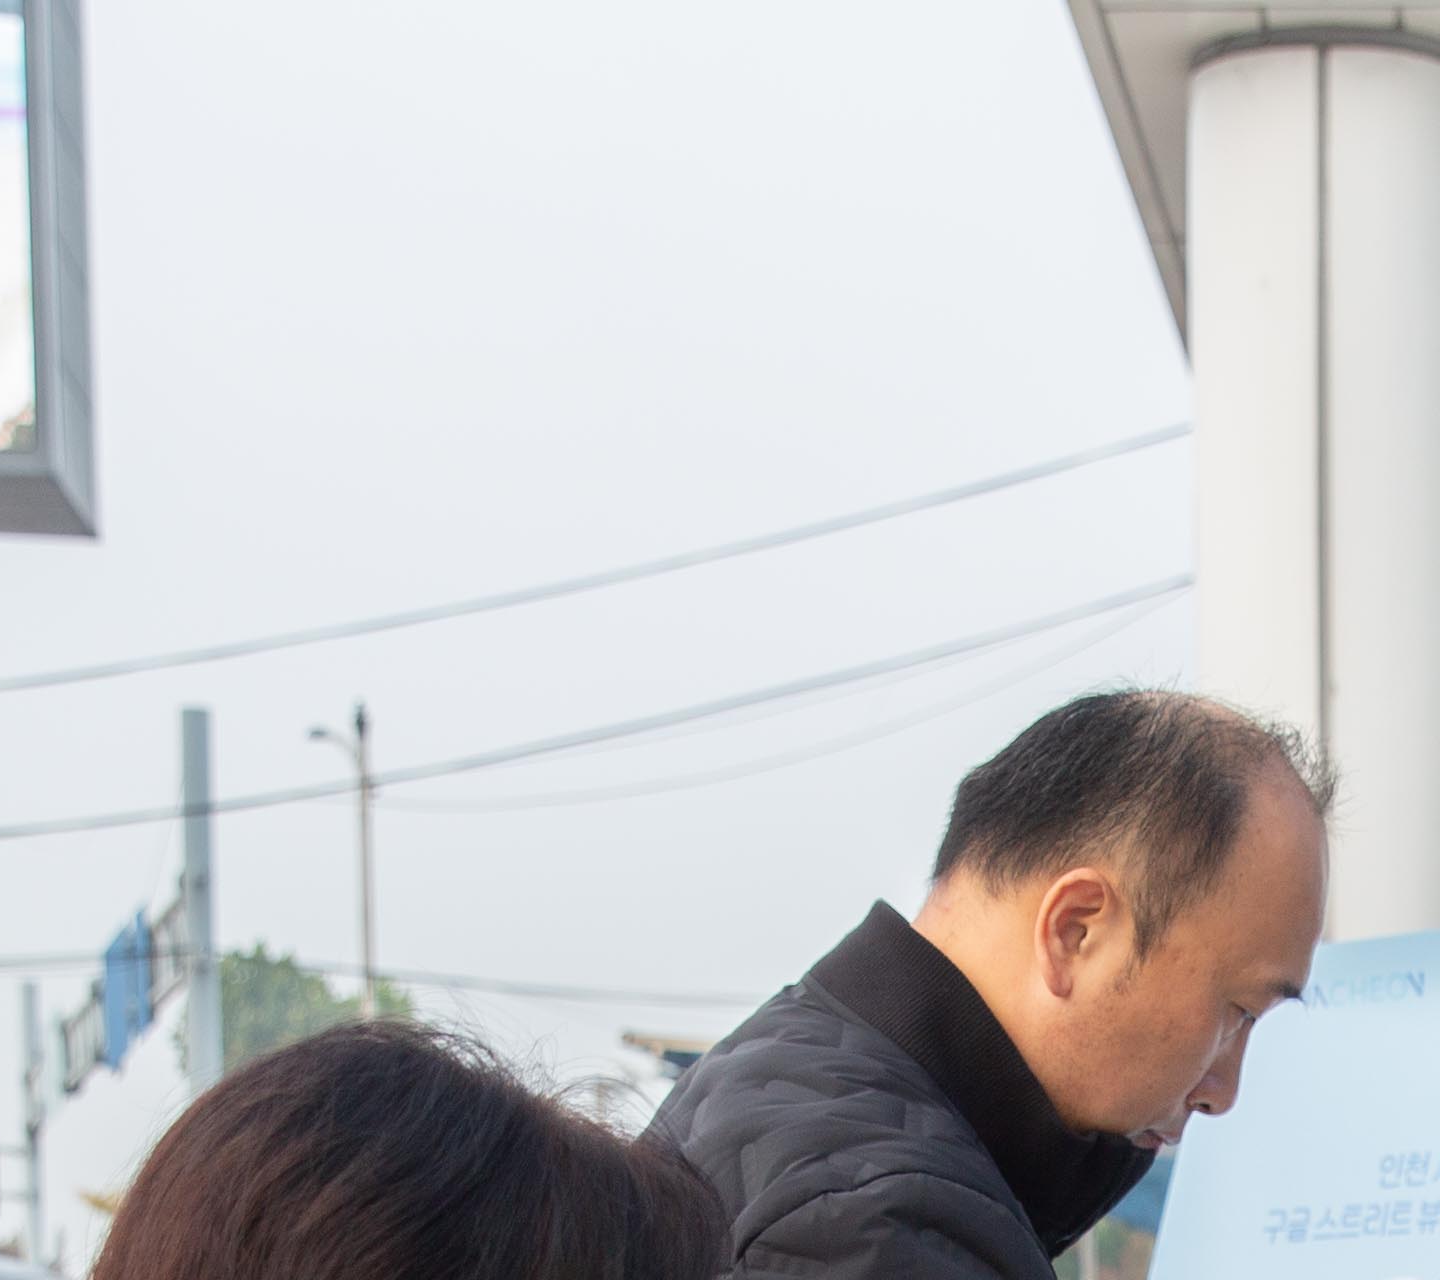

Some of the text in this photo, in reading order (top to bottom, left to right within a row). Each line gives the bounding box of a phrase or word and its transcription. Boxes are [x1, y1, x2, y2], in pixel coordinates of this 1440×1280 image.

[1379, 1153, 1433, 1190] 인천
[1263, 1207, 1312, 1245] 구글
[1313, 1200, 1413, 1242] 스트리트
